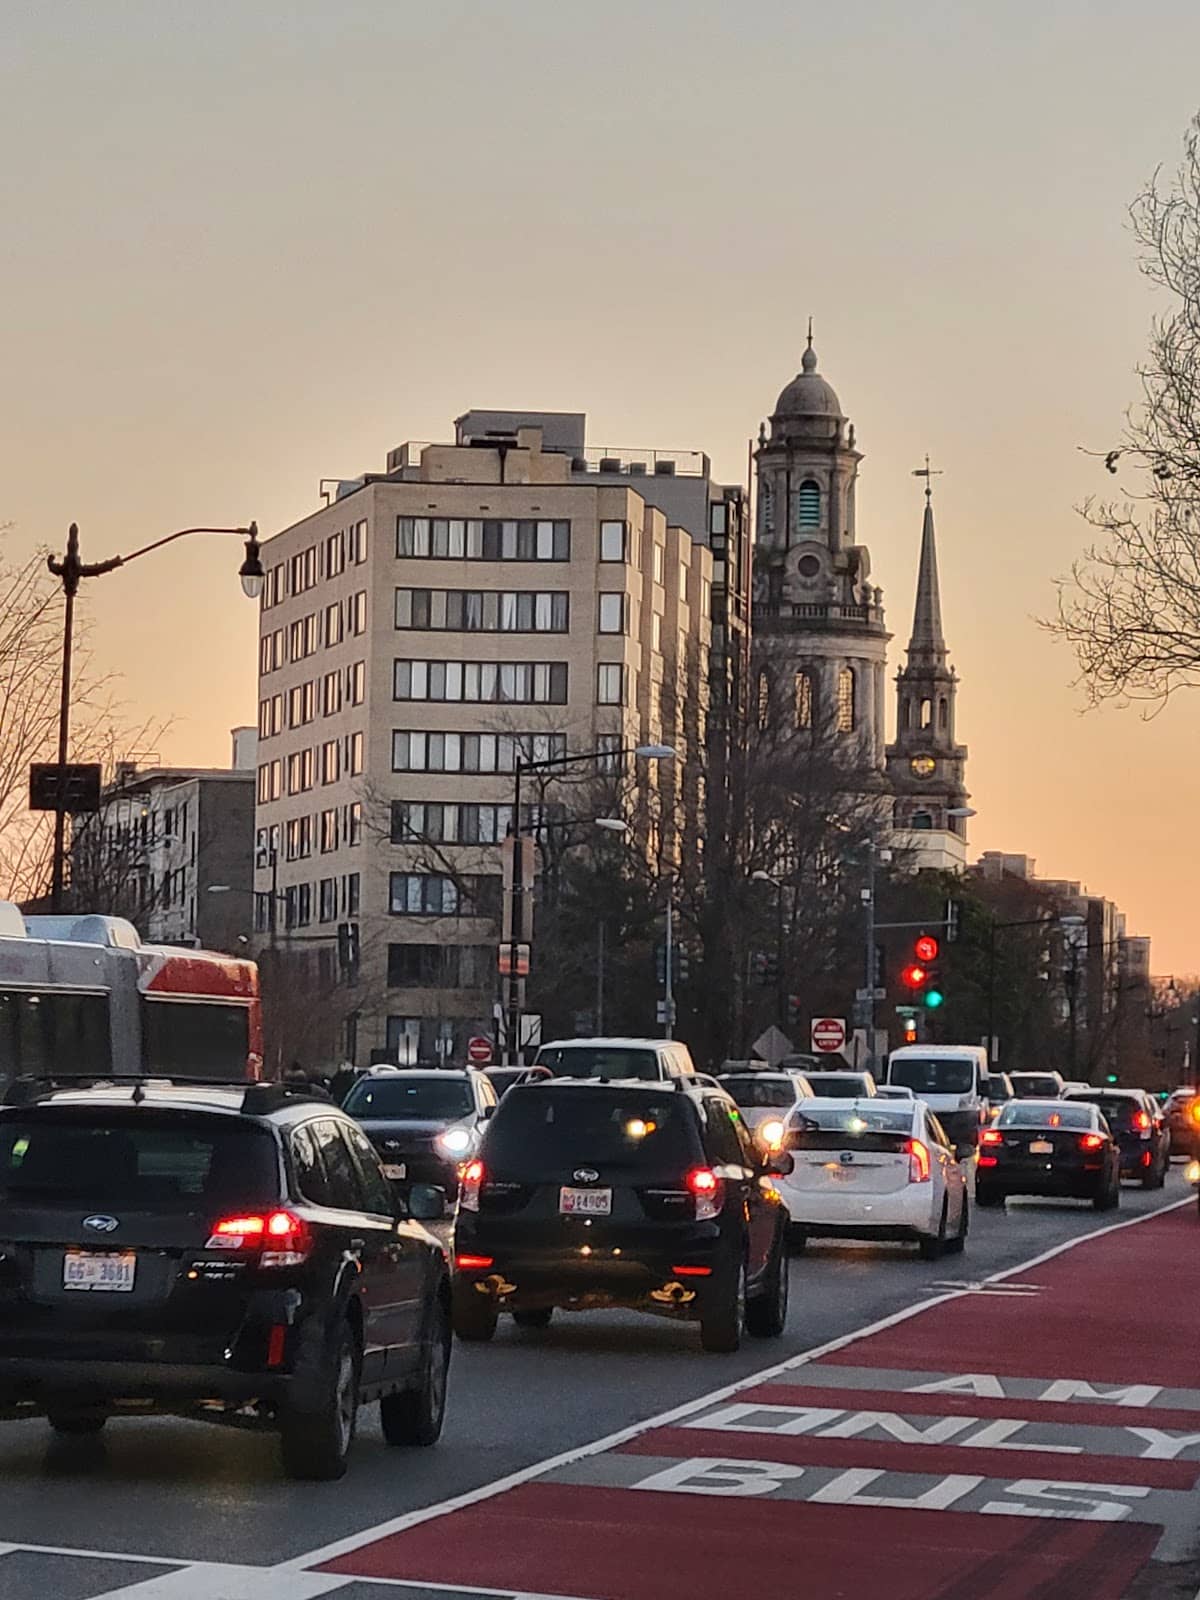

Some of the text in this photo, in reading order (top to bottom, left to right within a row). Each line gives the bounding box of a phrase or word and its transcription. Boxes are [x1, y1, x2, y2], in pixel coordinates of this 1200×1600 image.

[818, 1039, 839, 1047] ENTER
[903, 1373, 1164, 1408] AM
[681, 1403, 1200, 1460] ONLY
[629, 1457, 1152, 1522] BUS
